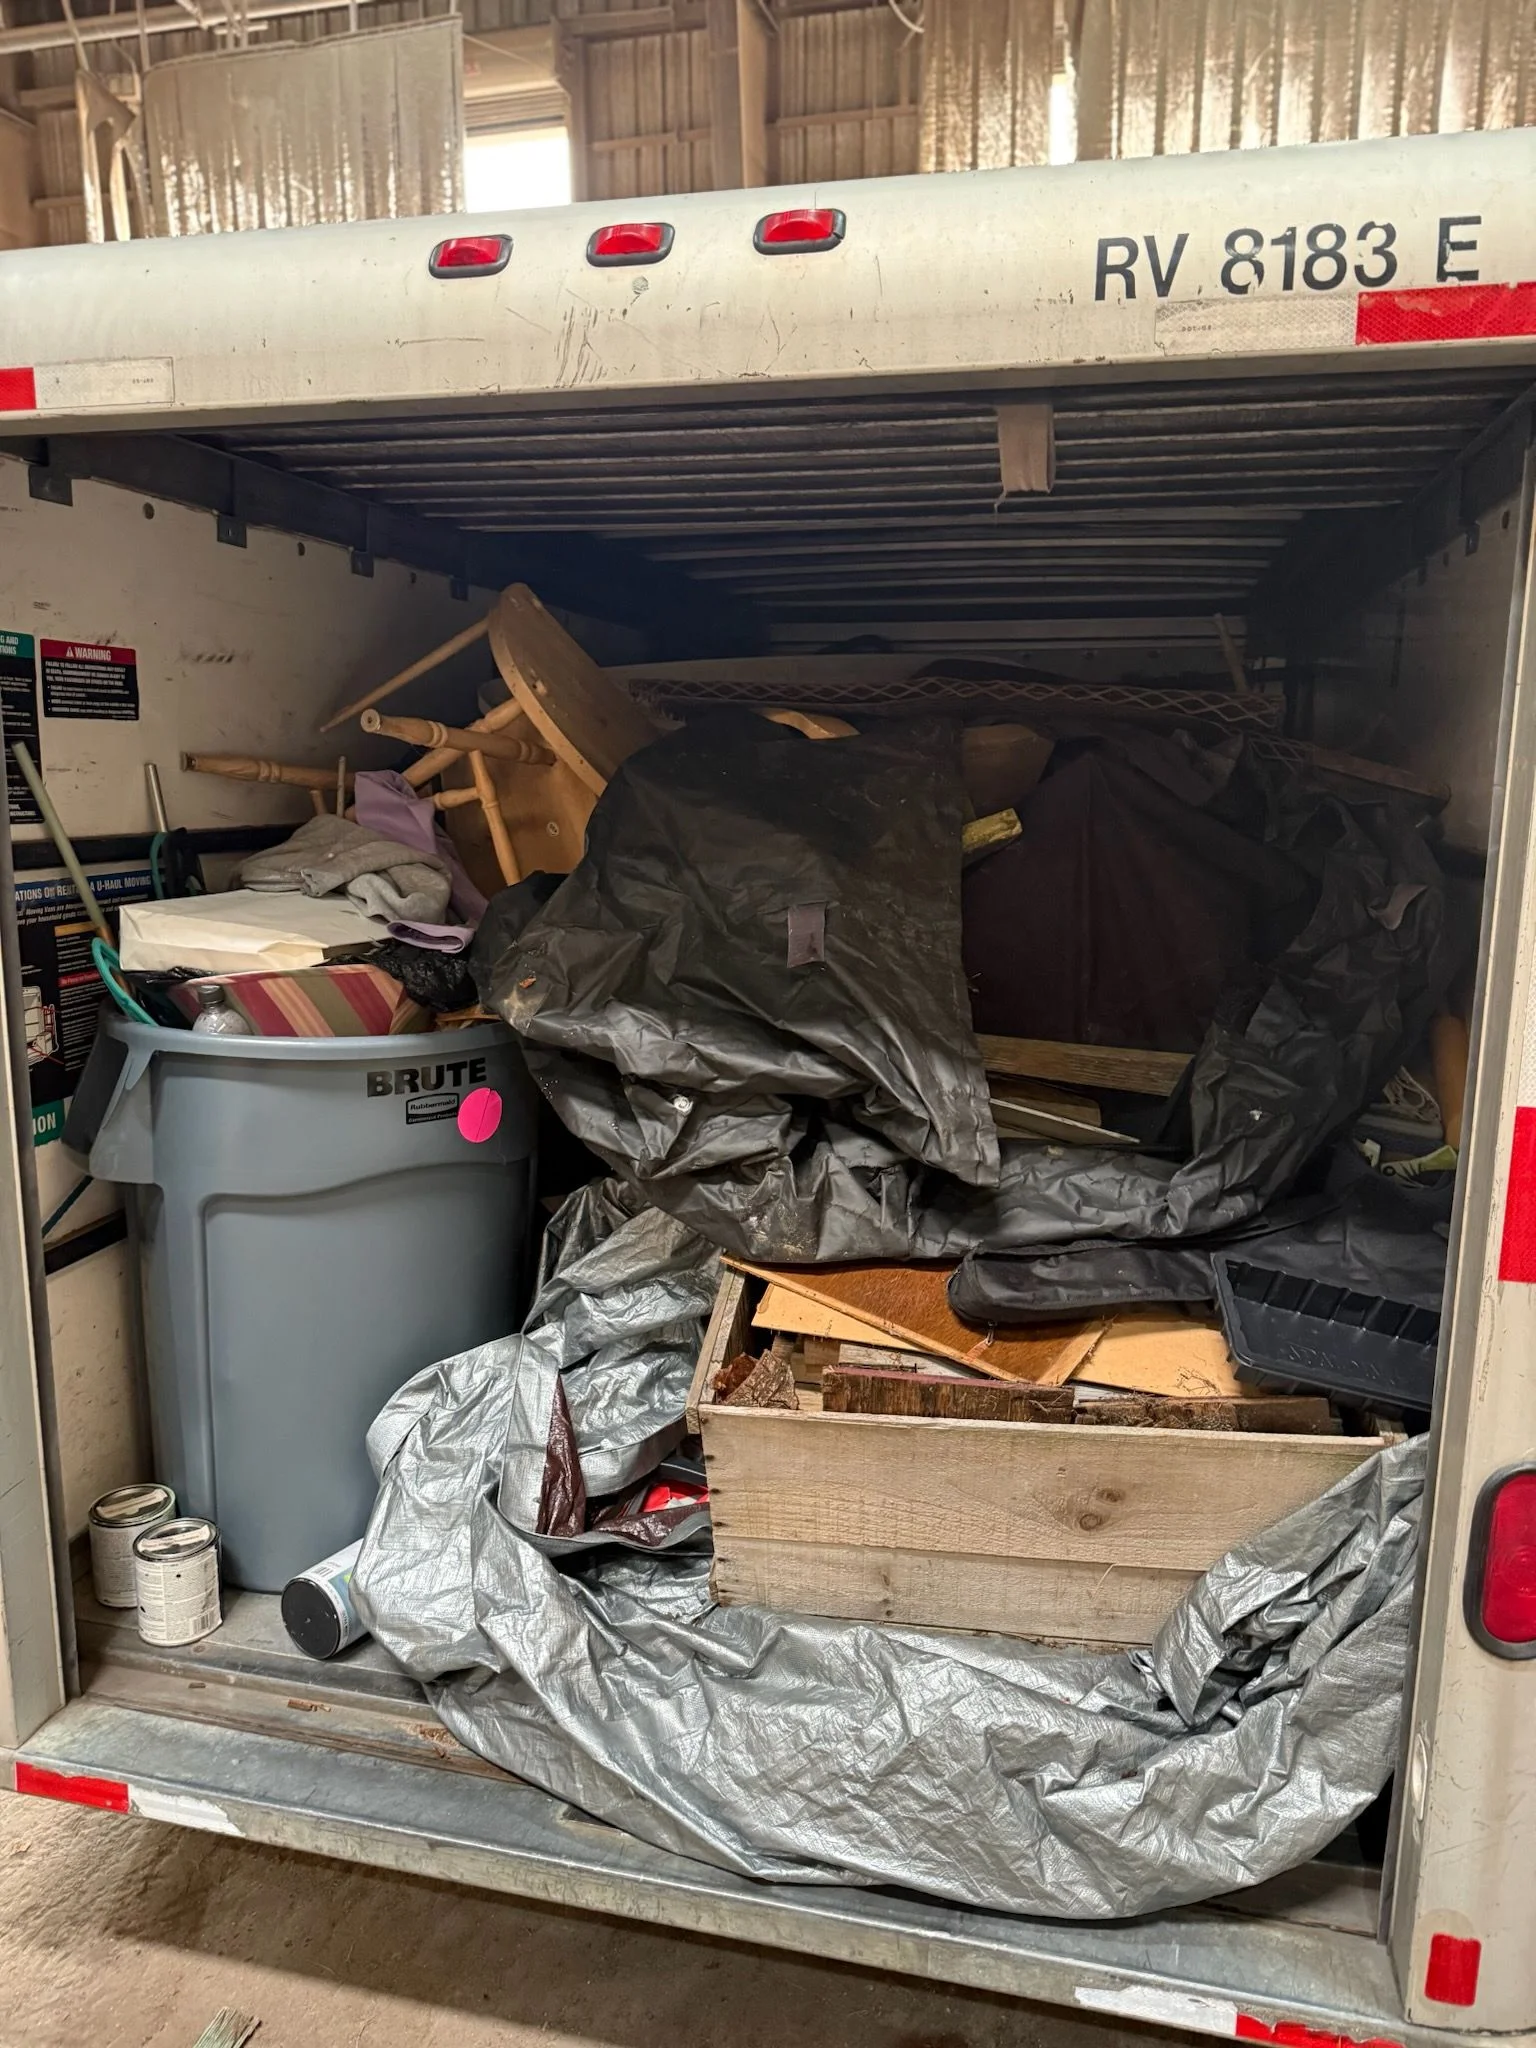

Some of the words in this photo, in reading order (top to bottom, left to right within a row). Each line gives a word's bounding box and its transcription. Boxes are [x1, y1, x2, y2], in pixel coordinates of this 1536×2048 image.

[1095, 233, 1189, 300] RV
[1220, 221, 1397, 295] 8183
[1437, 215, 1482, 283] E
[74, 646, 112, 661] WARNING
[15, 890, 42, 902] ATIONS
[97, 879, 122, 892] U-HAUL
[124, 875, 151, 888] MOVING
[367, 1057, 487, 1097] BRUTE
